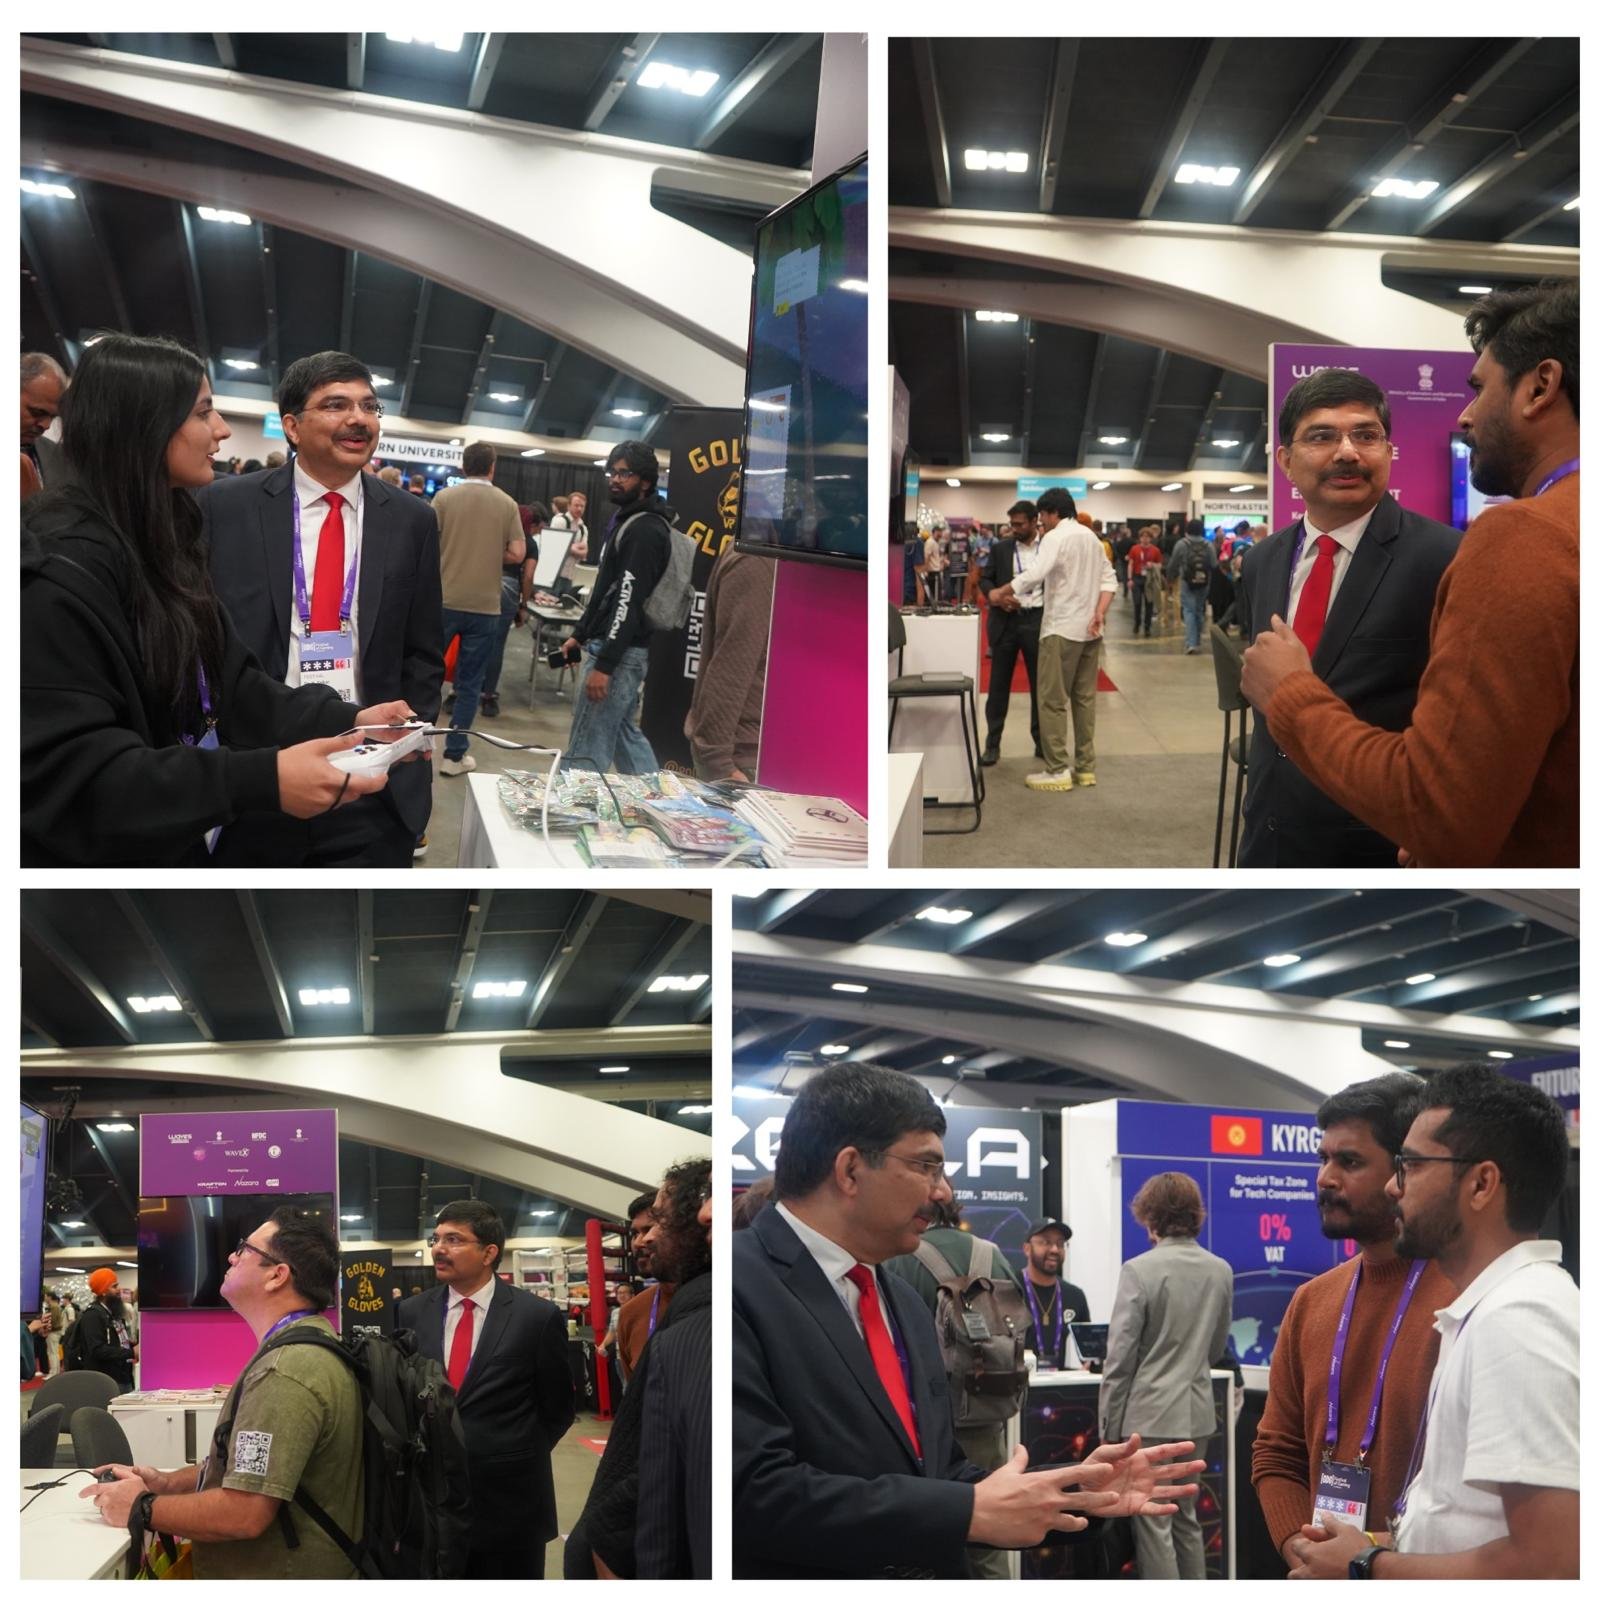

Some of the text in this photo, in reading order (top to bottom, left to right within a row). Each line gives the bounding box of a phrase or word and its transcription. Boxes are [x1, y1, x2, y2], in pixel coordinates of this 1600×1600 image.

[608, 569, 637, 640] ACTIVISION
[1235, 1174, 1308, 1188] Special Tax Zone
[1229, 1187, 1315, 1202] for Tech Companies
[1260, 1213, 1291, 1241] 0%
[1264, 1246, 1285, 1263] VAT
[346, 1262, 385, 1278] GOLDEN
[347, 1297, 384, 1312] GLOVES
